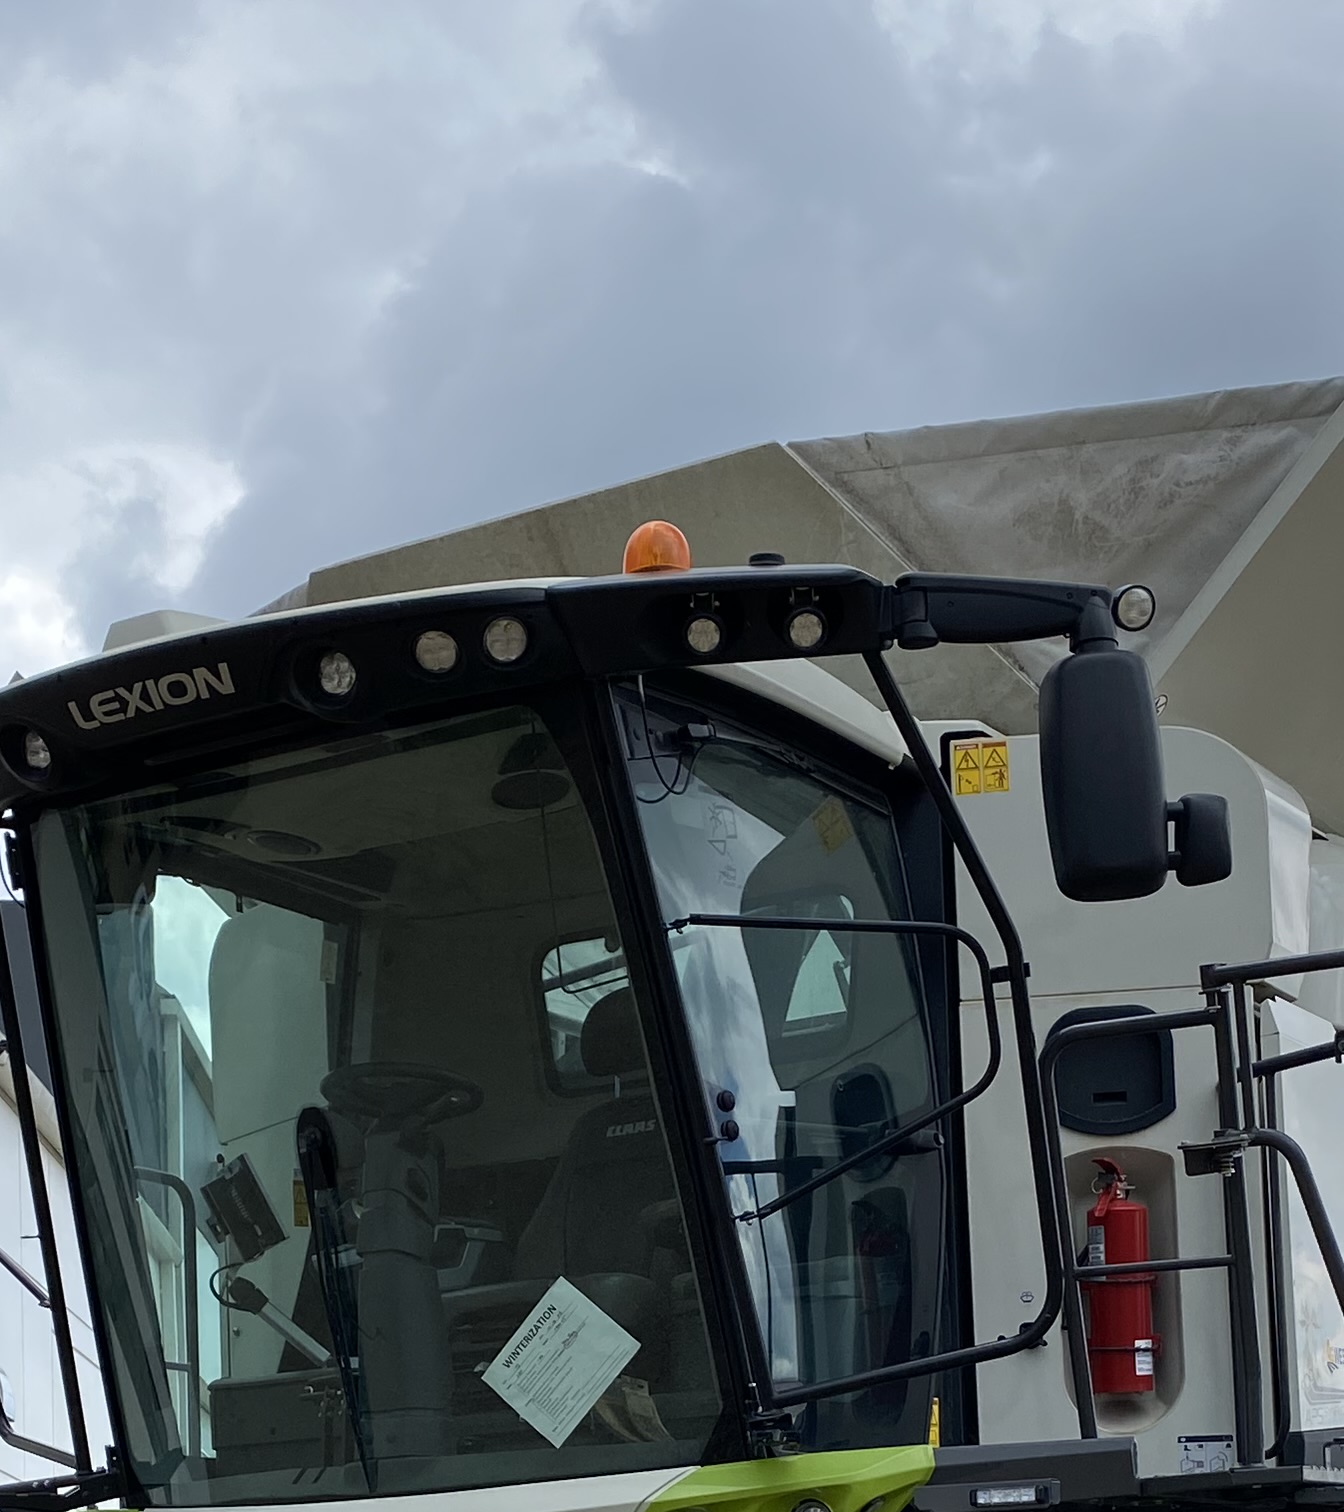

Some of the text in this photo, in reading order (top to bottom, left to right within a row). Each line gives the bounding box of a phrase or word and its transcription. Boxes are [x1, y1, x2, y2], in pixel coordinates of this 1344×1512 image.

[67, 662, 235, 730] LEXION
[606, 1119, 657, 1138] CLAAS
[501, 1303, 558, 1370] WINTERIZATION
